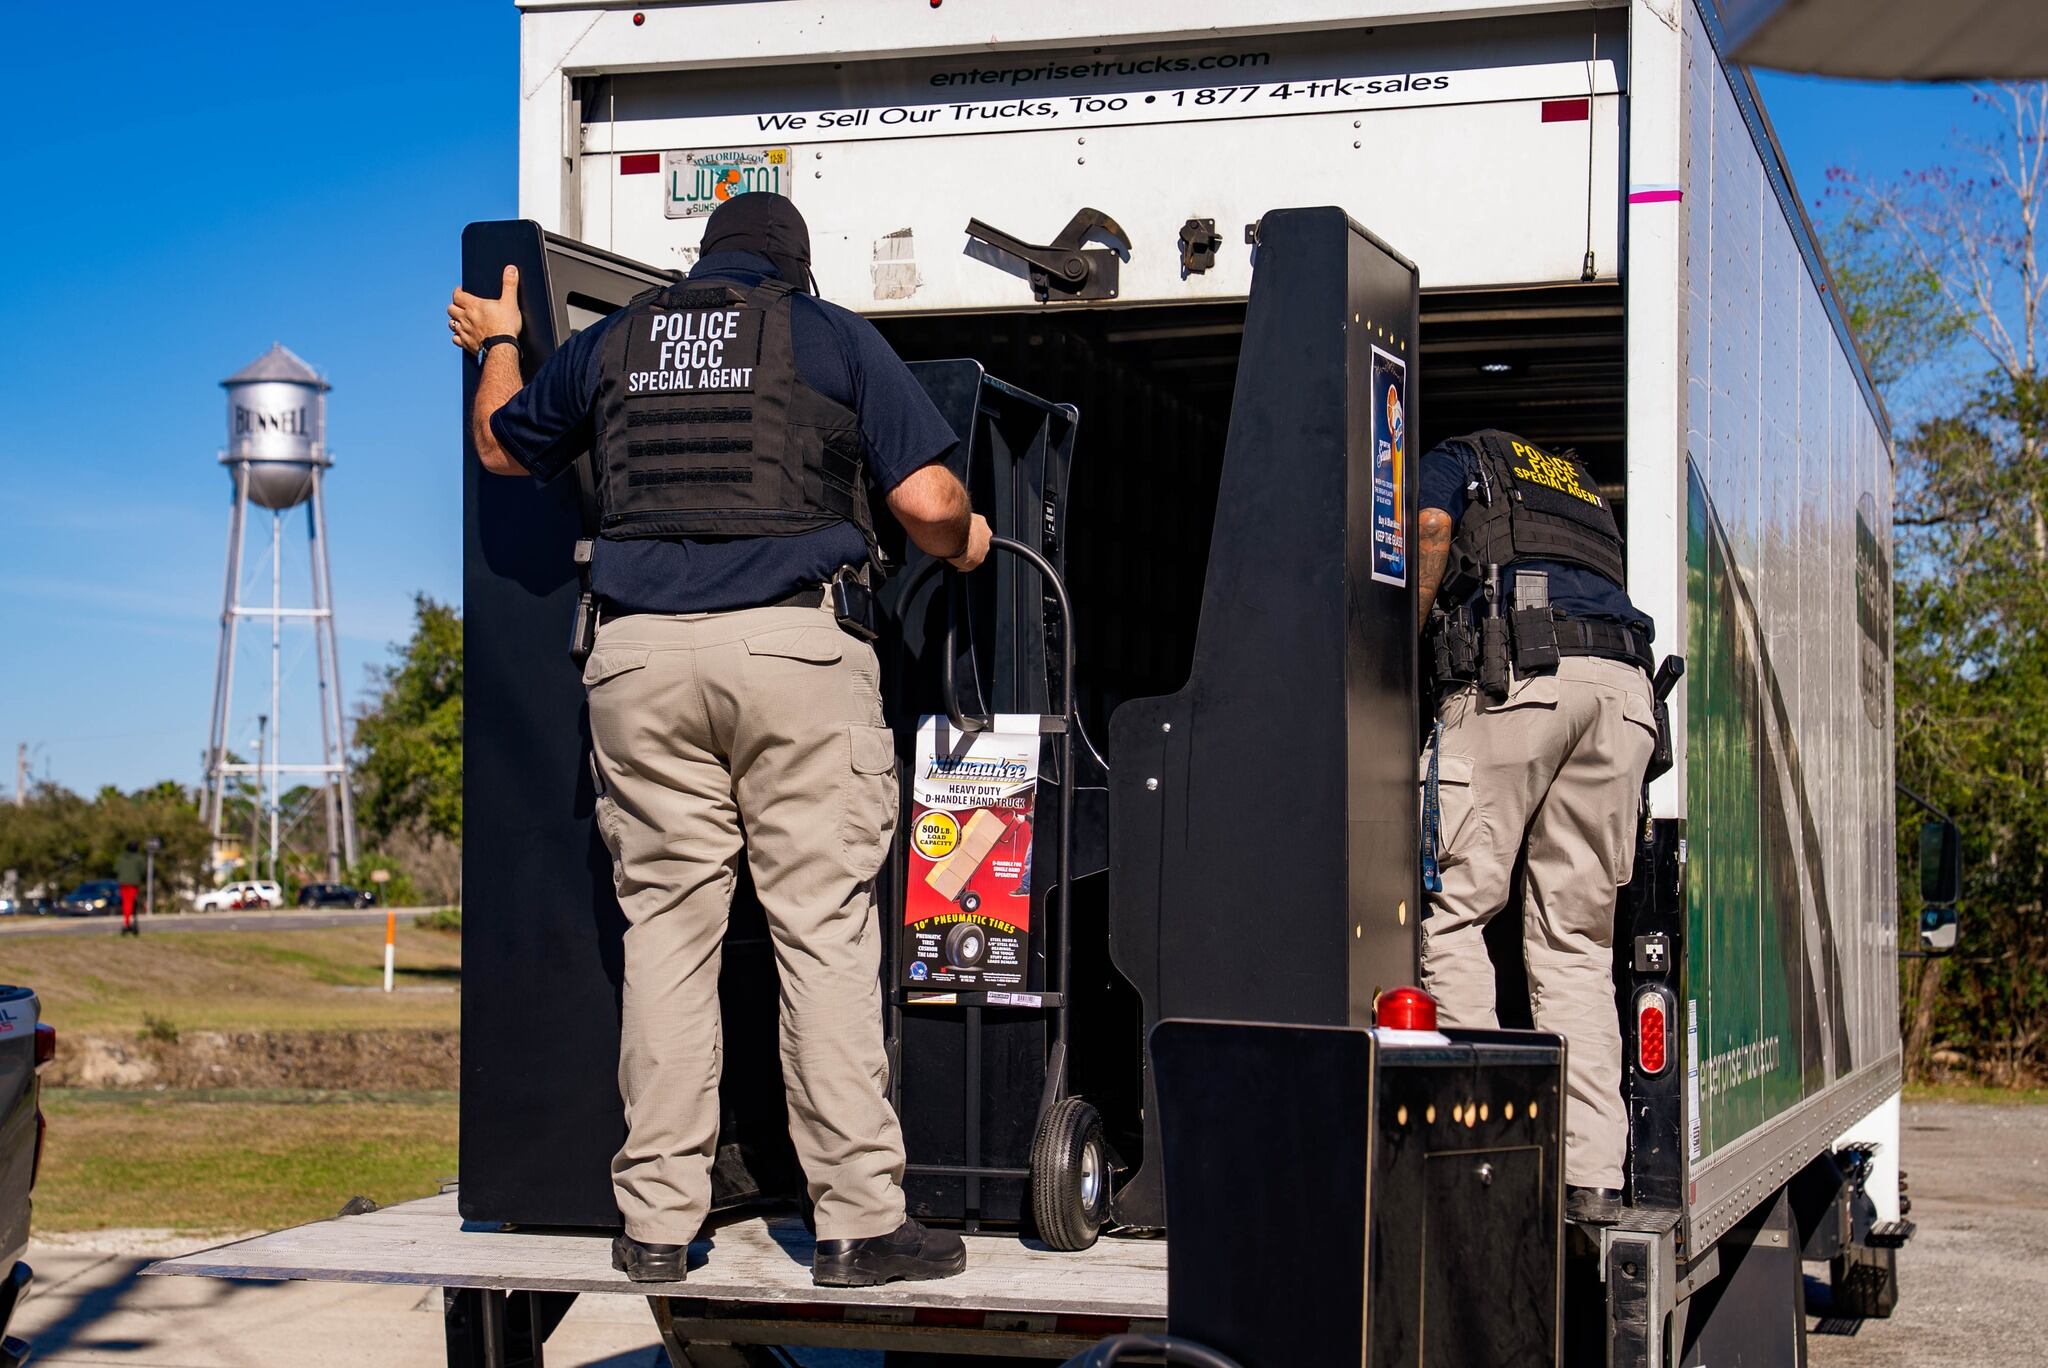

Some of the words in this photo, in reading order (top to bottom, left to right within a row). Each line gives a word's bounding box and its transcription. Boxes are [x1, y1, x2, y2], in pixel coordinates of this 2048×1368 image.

[929, 52, 1270, 87] enterprisetrucks.com
[757, 114, 807, 131] We
[816, 109, 870, 128] Sell
[879, 108, 942, 125] Our
[949, 99, 1059, 120] Trucks,
[1069, 97, 1128, 113] Too
[1269, 74, 1449, 100] 4-trk-sales
[672, 169, 714, 202] LJU
[650, 311, 741, 342] POLICE
[659, 339, 724, 370] FGCC
[628, 370, 694, 392] SPECIAL
[698, 368, 753, 389] AGENT
[1511, 441, 1580, 477] POLICE
[1528, 458, 1580, 488] FGCC
[1513, 467, 1566, 491] SPECIAL
[1567, 483, 1603, 508] AGENT
[1375, 529, 1385, 543] KEEP
[924, 753, 1027, 779] Milwaukee
[925, 794, 968, 805] D-HANDLE
[969, 797, 994, 807] HAND
[997, 798, 1025, 808] TRUCK
[949, 784, 976, 795] HEAVY
[978, 785, 1001, 796] DUTY
[922, 825, 940, 834] 800
[934, 913, 987, 925] PNEUMATIC
[988, 918, 1016, 934] TIRES
